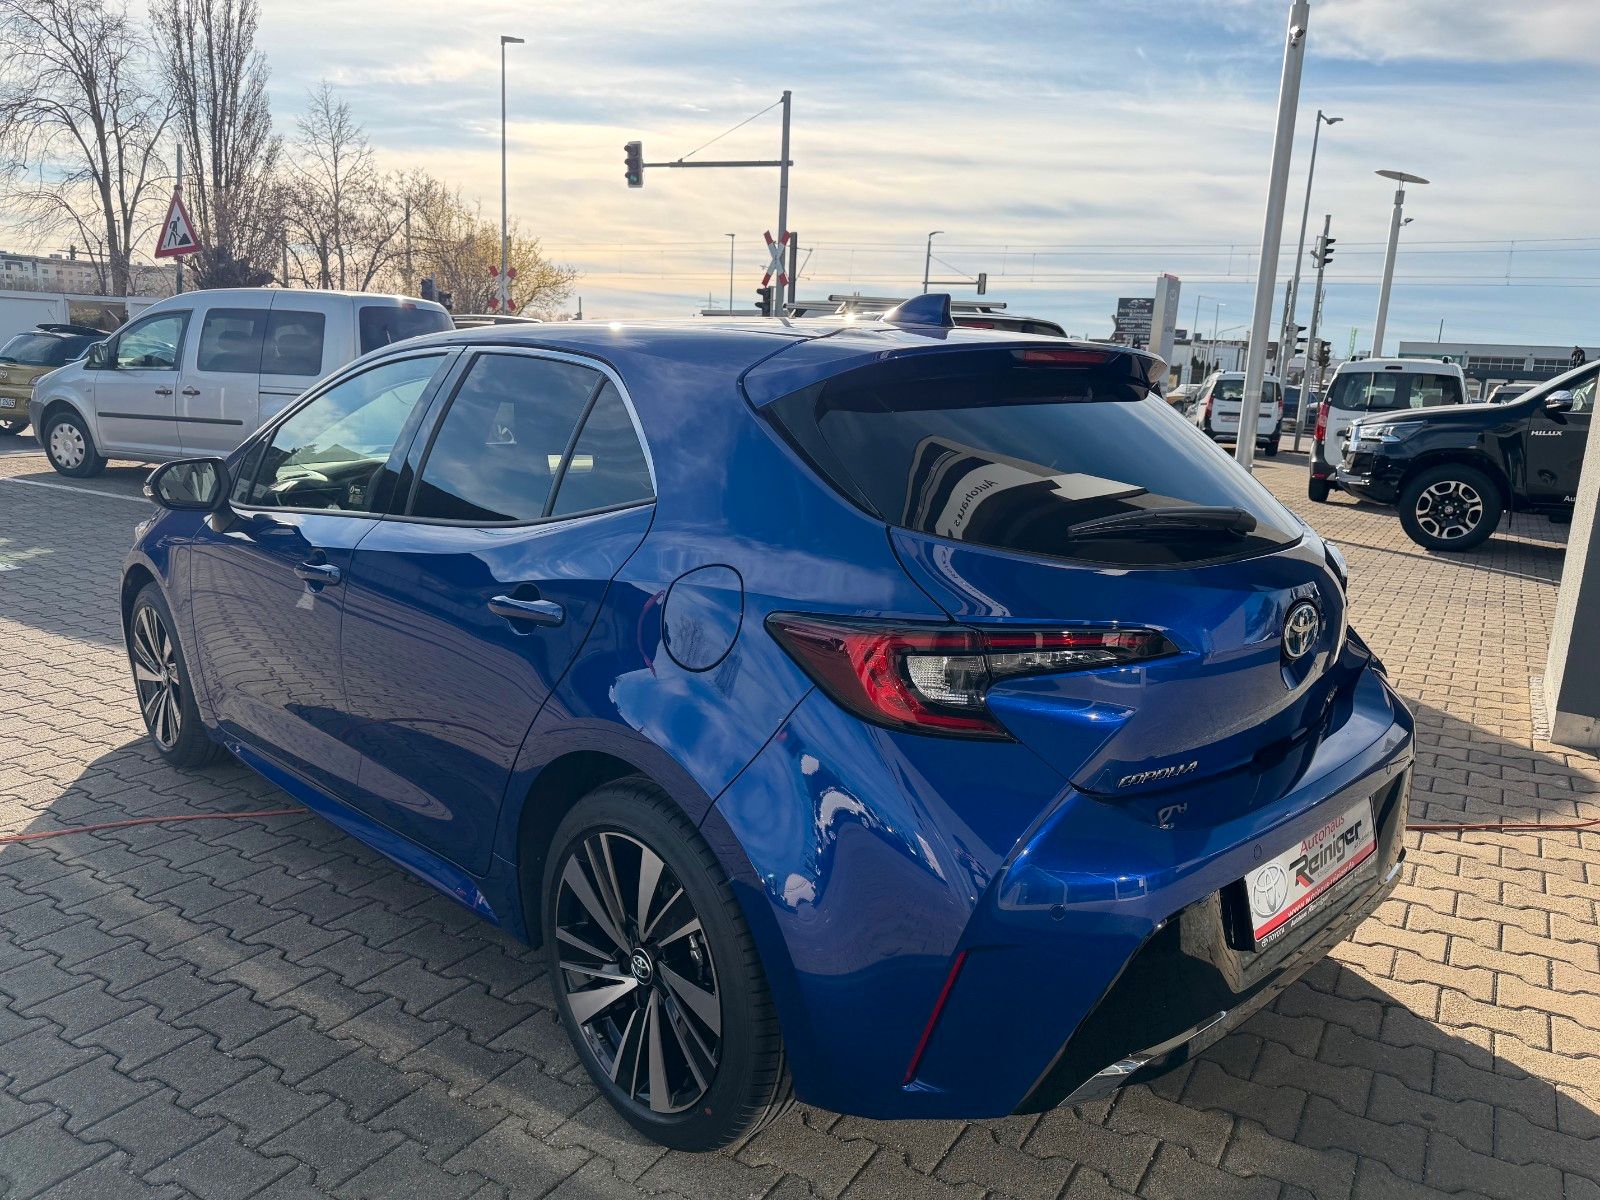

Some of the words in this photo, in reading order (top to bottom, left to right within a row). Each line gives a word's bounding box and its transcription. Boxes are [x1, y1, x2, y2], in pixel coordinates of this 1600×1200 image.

[1117, 760, 1198, 789] COROLLA
[1300, 815, 1345, 854] Autohaus
[1289, 820, 1362, 888] Reiniger
[1268, 927, 1285, 942] TOYOTA
